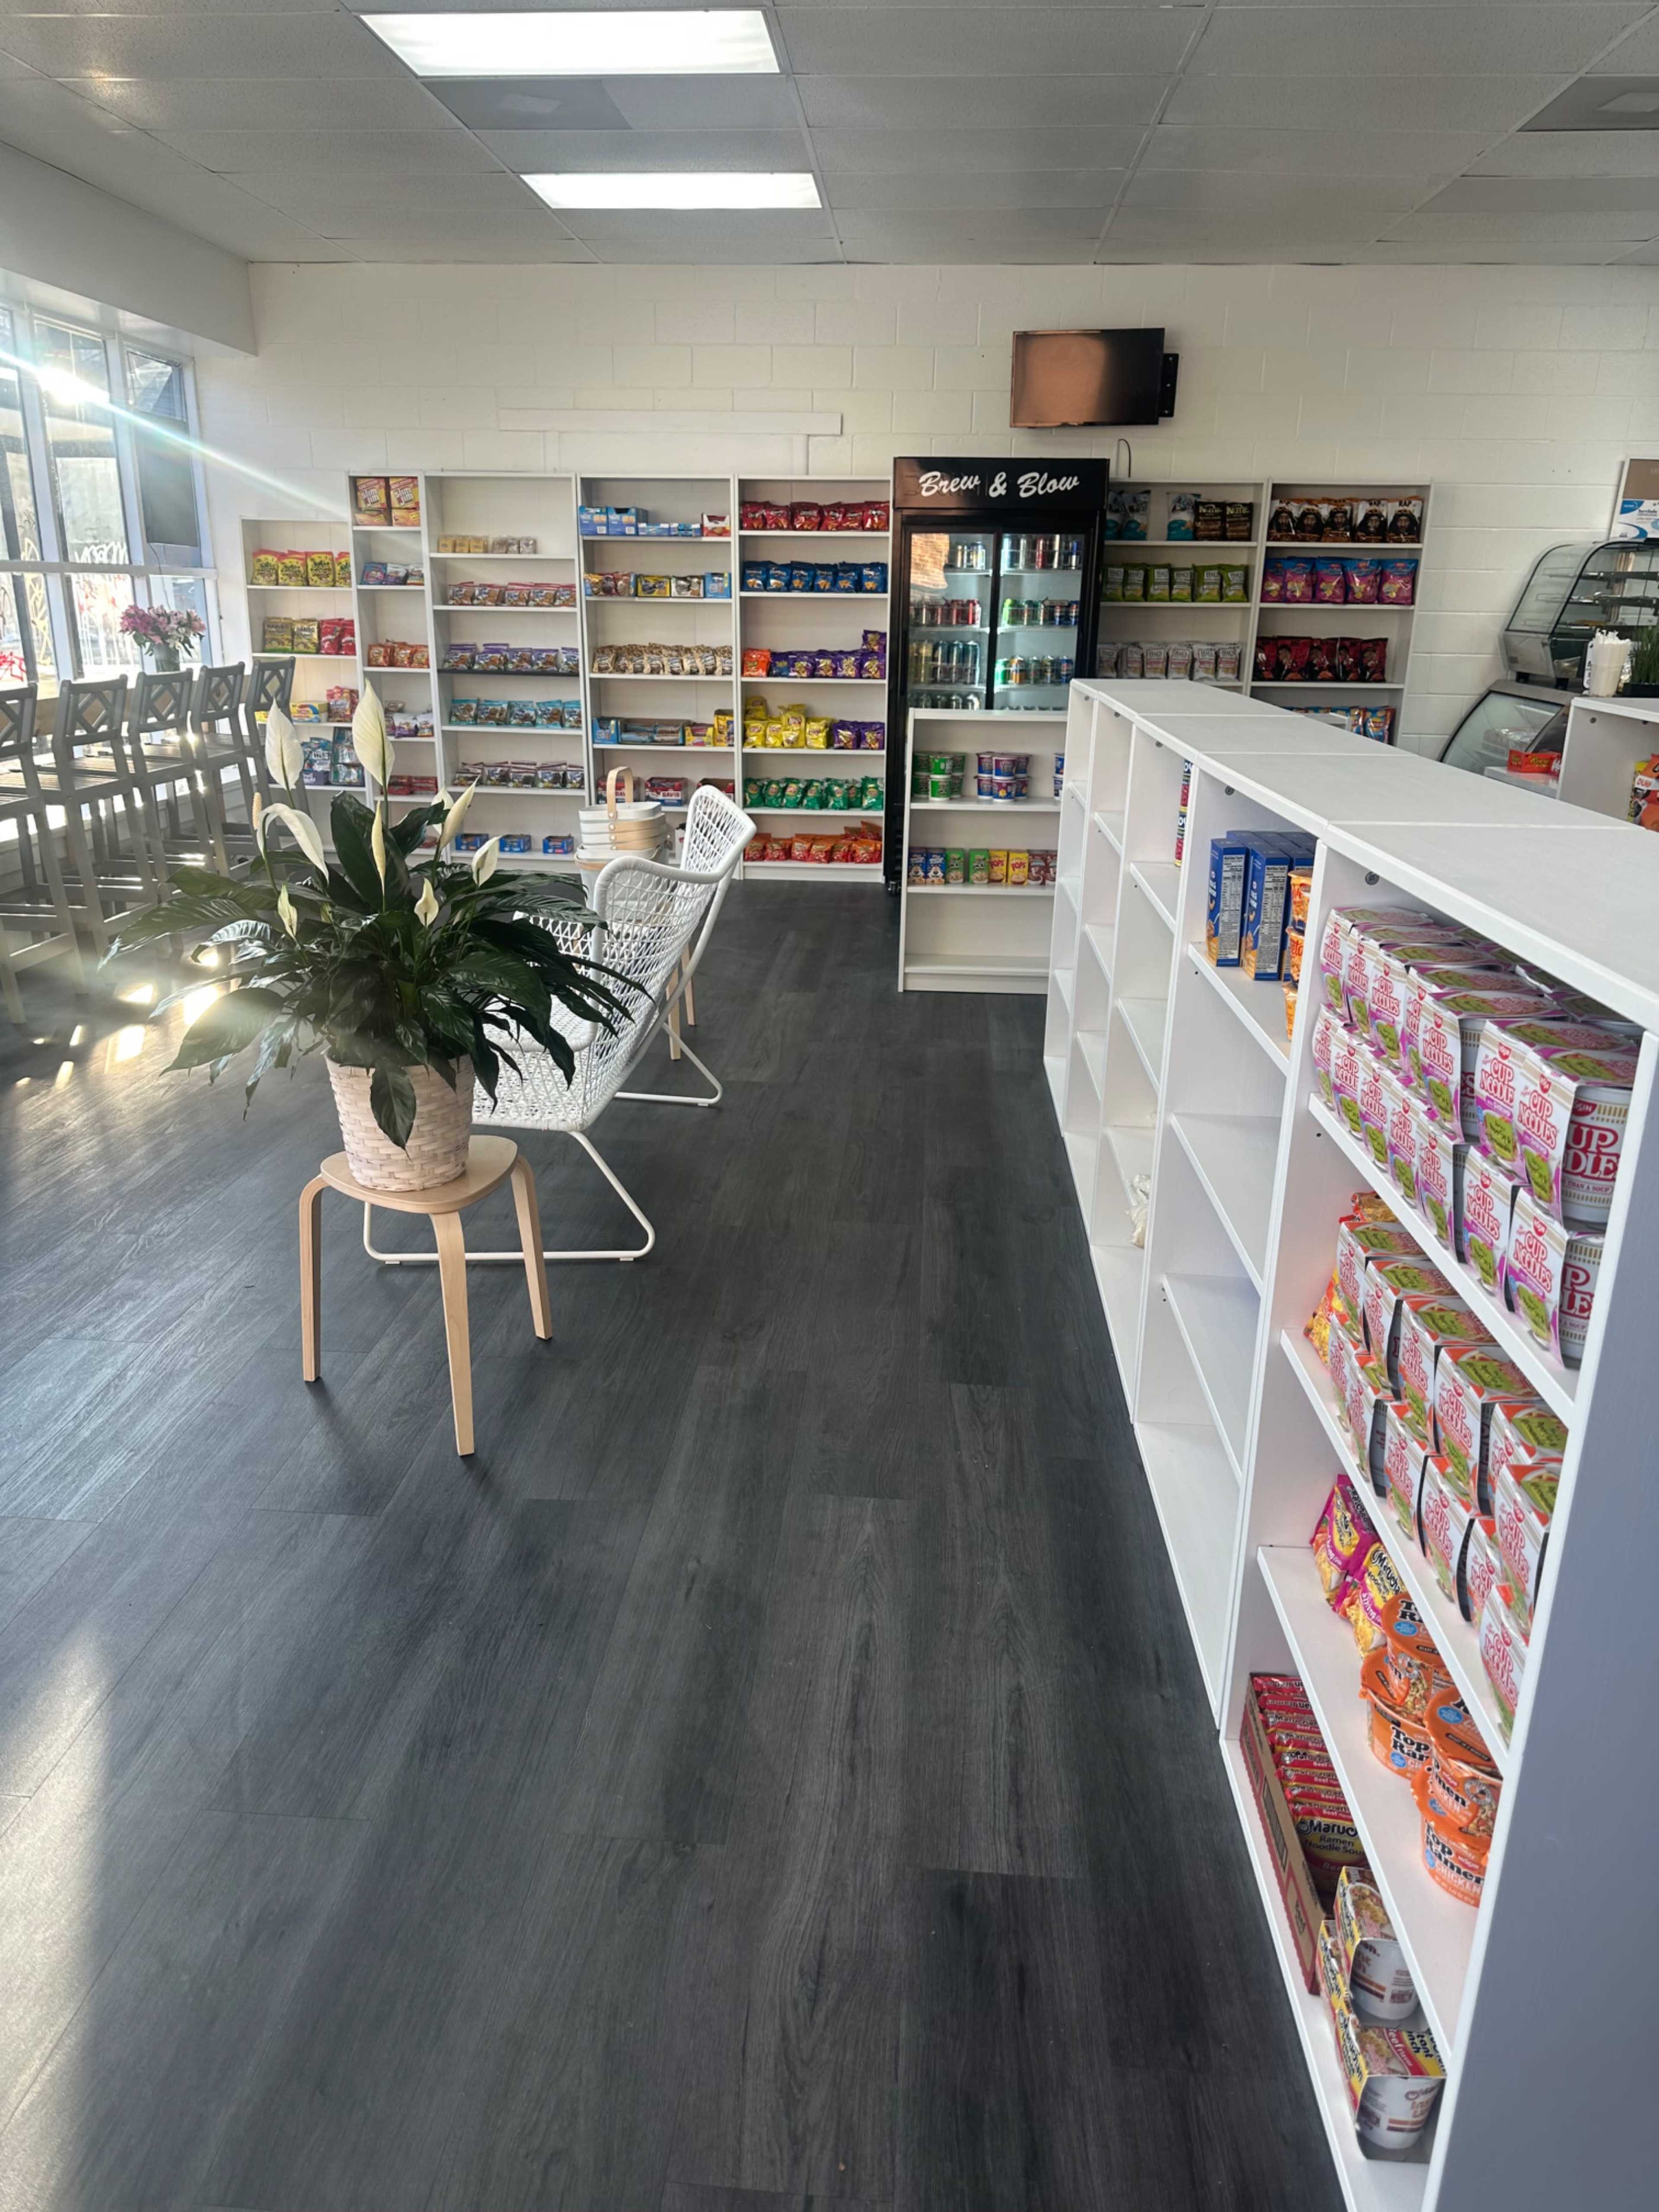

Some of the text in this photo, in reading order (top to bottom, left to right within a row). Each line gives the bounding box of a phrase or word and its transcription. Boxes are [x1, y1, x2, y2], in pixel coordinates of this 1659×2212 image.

[918, 471, 1080, 498] Brew & Blow
[1371, 986, 1400, 1016] NOODLES
[1378, 976, 1393, 995] CUP
[1429, 1027, 1447, 1050] CUP
[1341, 1055, 1359, 1074] CUP
[1423, 1038, 1454, 1075] NOODLES
[1491, 1058, 1515, 1085] CUP
[1367, 1081, 1382, 1101] CUP
[1480, 1068, 1516, 1108] NOODLE
[1360, 1089, 1387, 1124] NOODLES
[1529, 1090, 1553, 1121] CUP
[1397, 1111, 1412, 1134] CUP
[1517, 1100, 1557, 1150] NOODLES
[1567, 1121, 1619, 1153] UP
[1389, 1119, 1416, 1158] NOODLES
[1425, 1146, 1441, 1171] CUP
[1419, 1154, 1447, 1197] NOODLES
[1569, 1180, 1585, 1189] THAN
[1592, 1184, 1611, 1193] SOUP
[1474, 1184, 1494, 1213] CUP
[1466, 1192, 1500, 1241] NOODLES
[1524, 1231, 1548, 1262] CUP
[1513, 1239, 1552, 1293] NOODLES
[1438, 1392, 1473, 1449] NOODLES
[1447, 1389, 1467, 1421] CUP
[1506, 1512, 1526, 1550] CUP
[1498, 1514, 1530, 1584] NOODLES
[1376, 1550, 1403, 1595] Marucha
[1493, 1633, 1513, 1673] CUP
[1391, 1725, 1430, 1751] Top
[1435, 1773, 1467, 1808] men
[1307, 1819, 1358, 1837] Maruc
[1319, 1835, 1354, 1847] Ramen
[1305, 1839, 1341, 1851] Noodle
[1436, 1862, 1481, 1896] CHICKEN
[1416, 2033, 1434, 2058] tant
